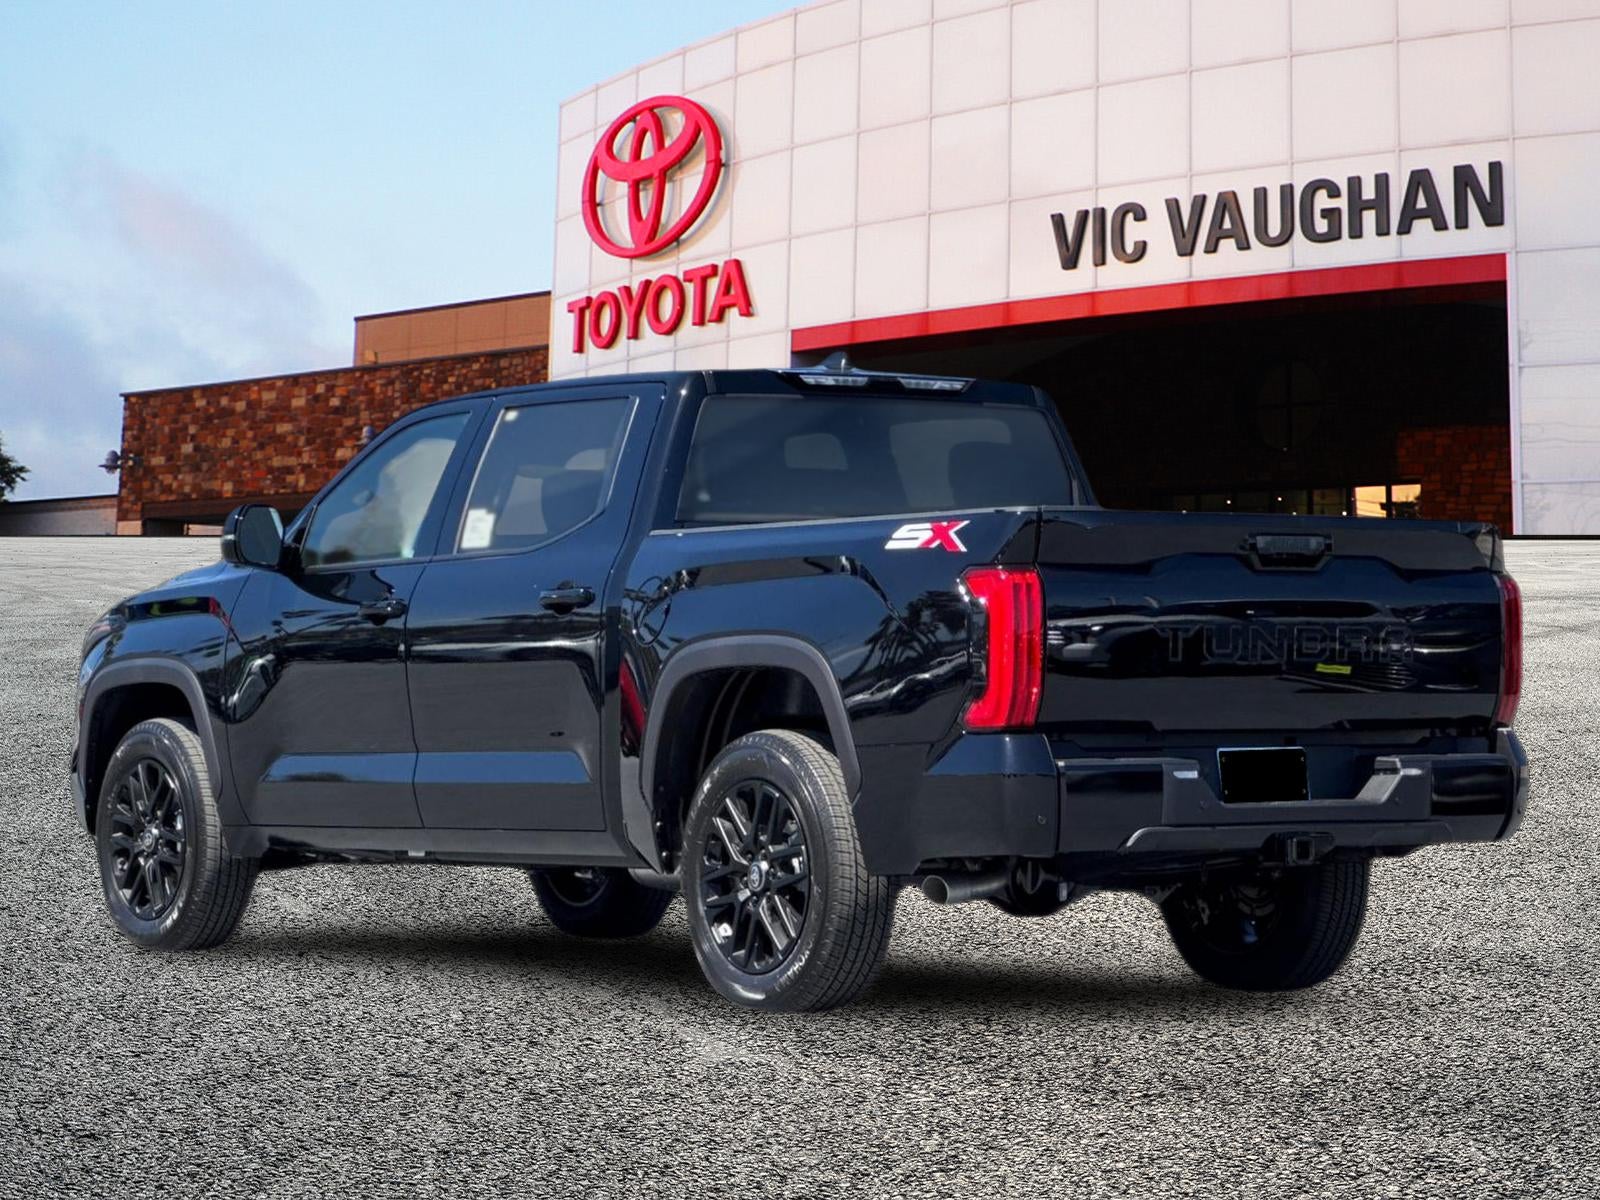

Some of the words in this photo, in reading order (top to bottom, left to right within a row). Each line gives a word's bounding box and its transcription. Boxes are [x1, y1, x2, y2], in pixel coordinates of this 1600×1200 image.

[1050, 201, 1147, 270] VIC
[1165, 160, 1505, 257] VAUGHAN
[567, 258, 754, 354] TOYOTA
[1151, 623, 1414, 663] TUNDRA
